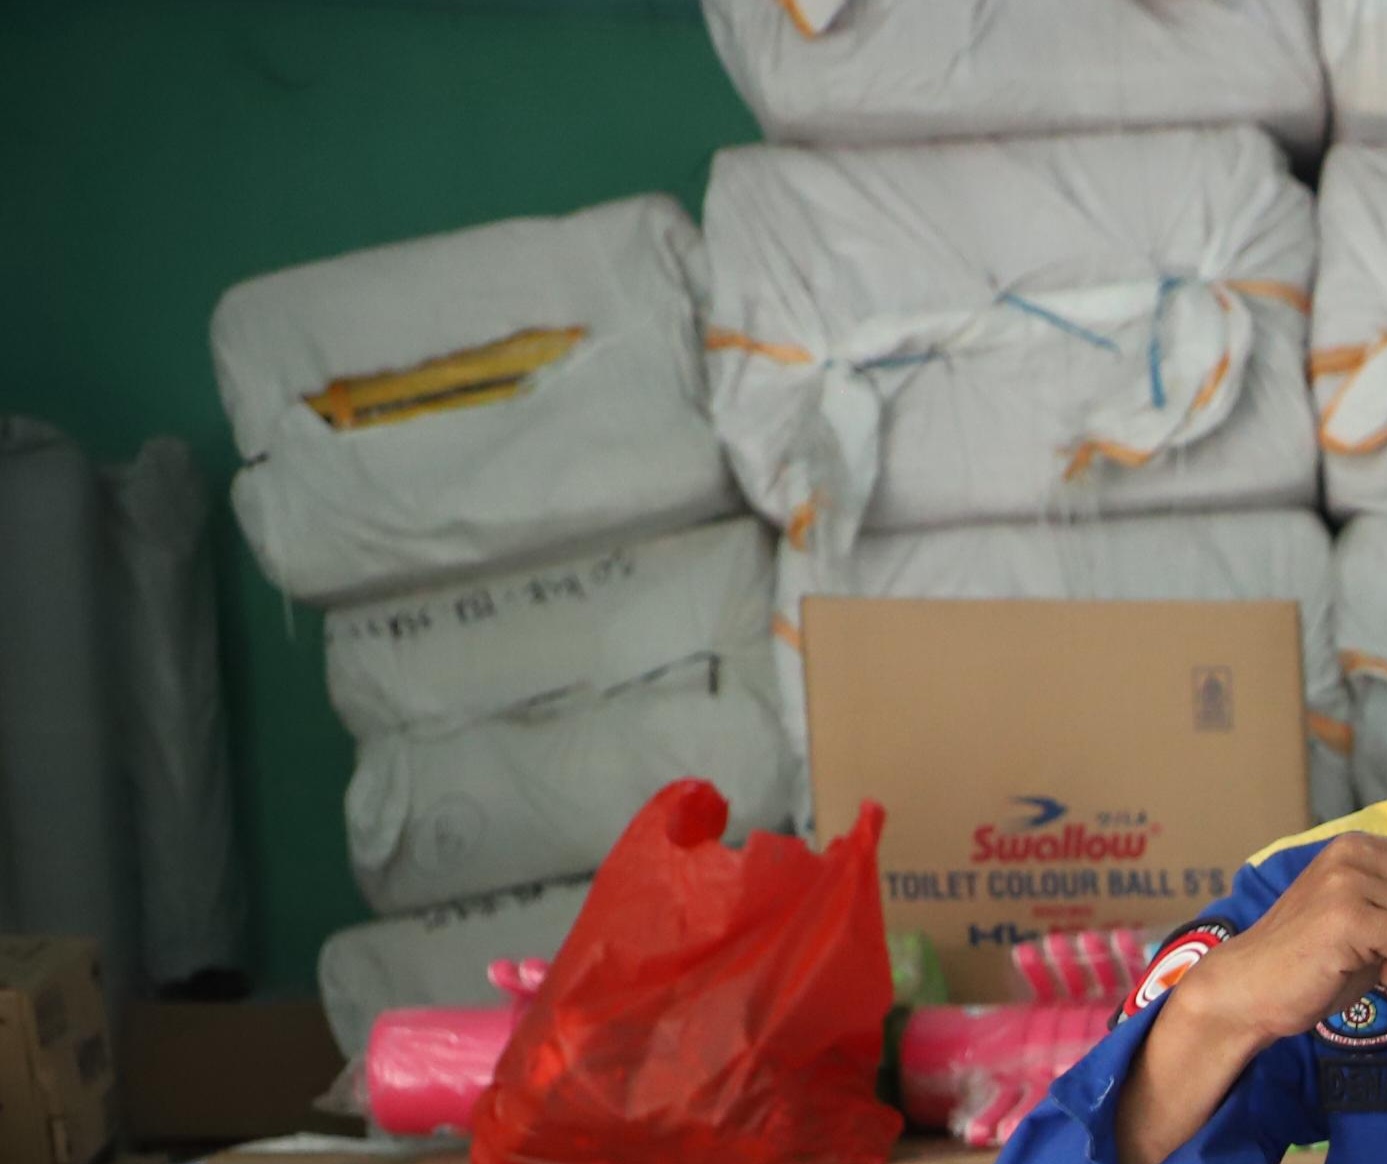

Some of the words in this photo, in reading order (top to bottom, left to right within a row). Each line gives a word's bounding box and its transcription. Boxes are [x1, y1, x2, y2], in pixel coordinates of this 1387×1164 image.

[971, 825, 1147, 864] Swallow
[887, 872, 978, 898] TOILET
[988, 870, 1098, 898] COLOUR
[1108, 869, 1174, 897] BALL
